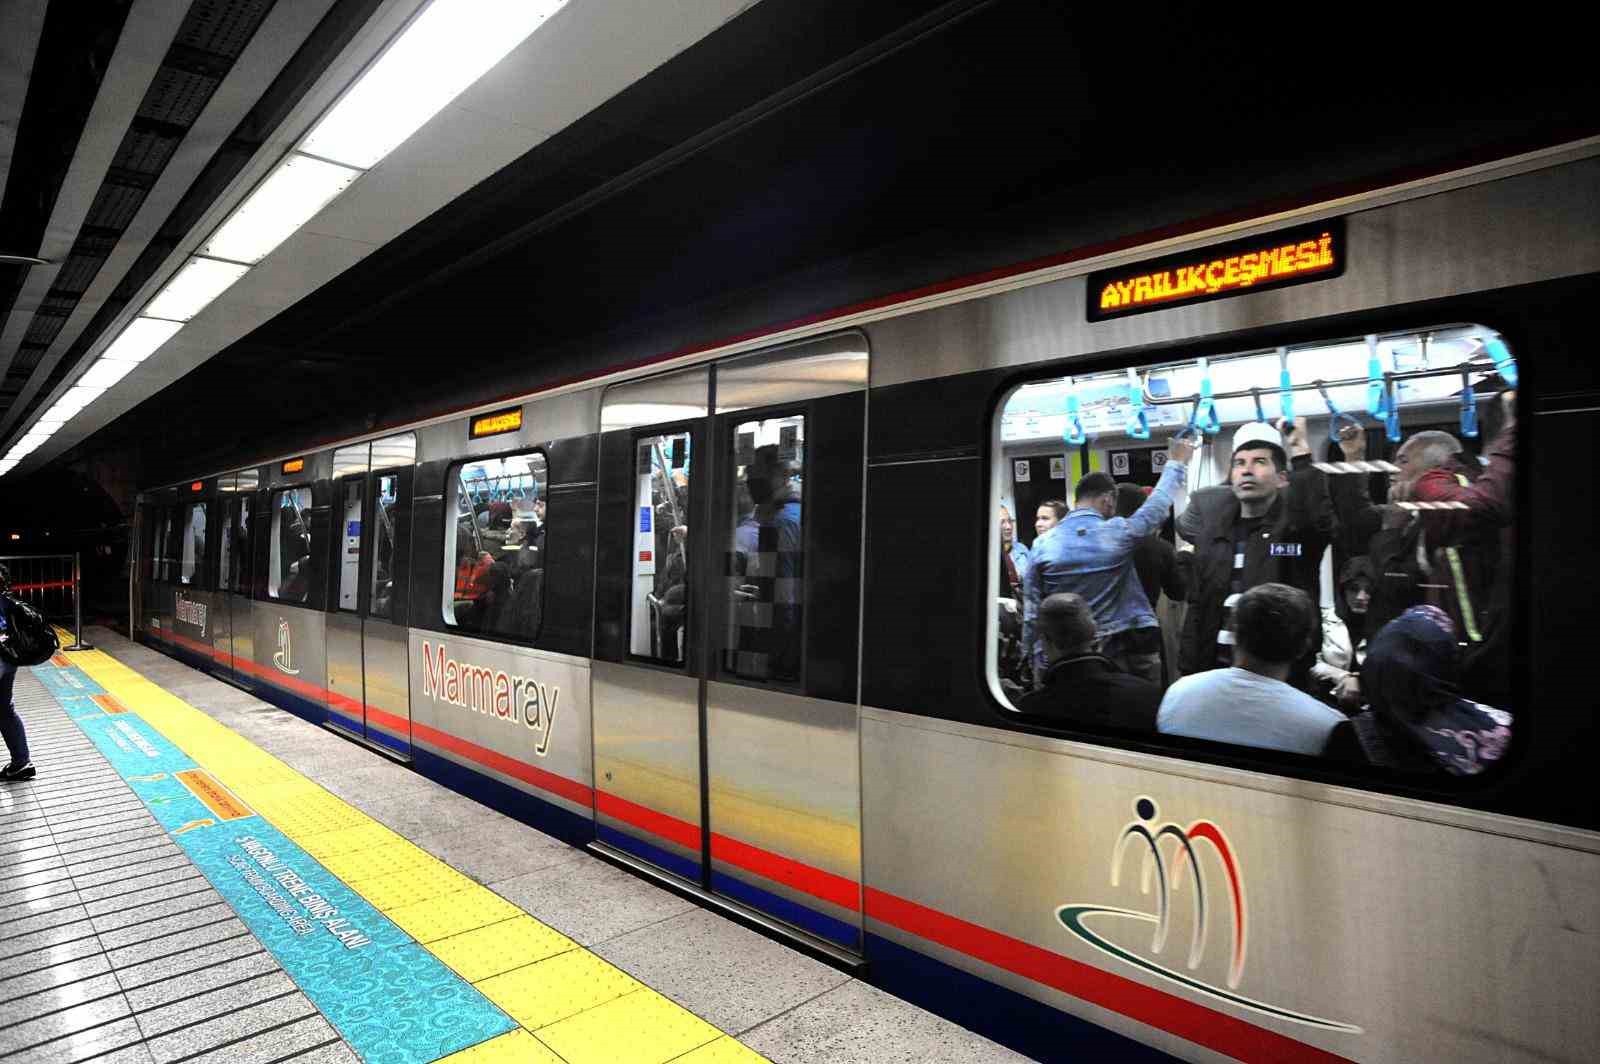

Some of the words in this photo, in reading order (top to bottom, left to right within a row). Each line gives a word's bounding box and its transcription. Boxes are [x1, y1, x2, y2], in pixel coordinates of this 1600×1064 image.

[423, 641, 560, 755] Marmaray
[272, 867, 314, 898] TRENE
[320, 918, 371, 949] ALANI
